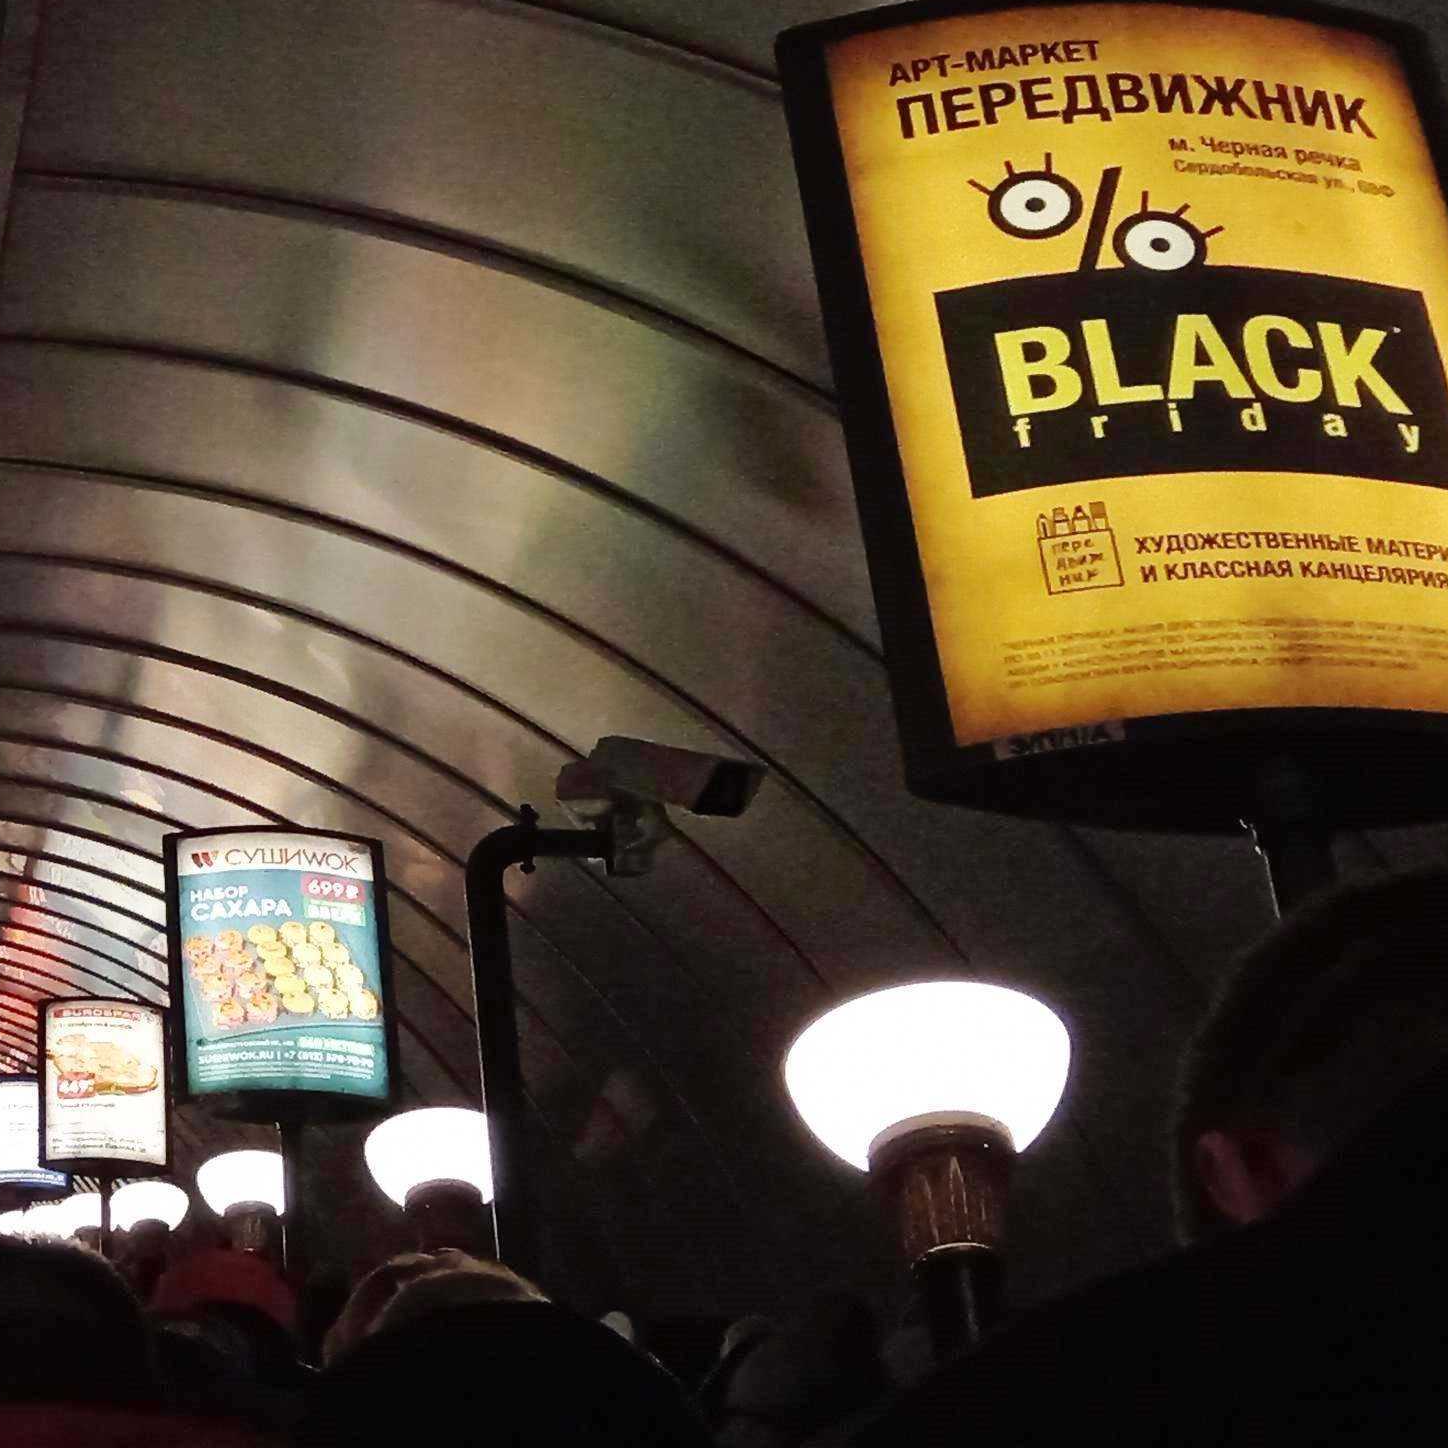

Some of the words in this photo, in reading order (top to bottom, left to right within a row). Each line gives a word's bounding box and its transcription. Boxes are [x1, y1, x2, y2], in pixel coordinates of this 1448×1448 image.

[888, 39, 1099, 87] АРТ-МАРКЕТ
[895, 72, 1377, 140] ПЕРЕДВИЖНИК
[1201, 136, 1288, 159] Черная
[1294, 149, 1362, 172] речка
[994, 313, 1413, 416] BLACK
[1013, 403, 1420, 453] friday
[1134, 530, 1361, 555] ХУДОЖЕСТВЕННЫЕ
[1141, 566, 1158, 584] И
[1165, 559, 1293, 580] КЛАССНАЯ
[190, 885, 249, 902] НАБОР
[190, 898, 293, 921] САХАРА
